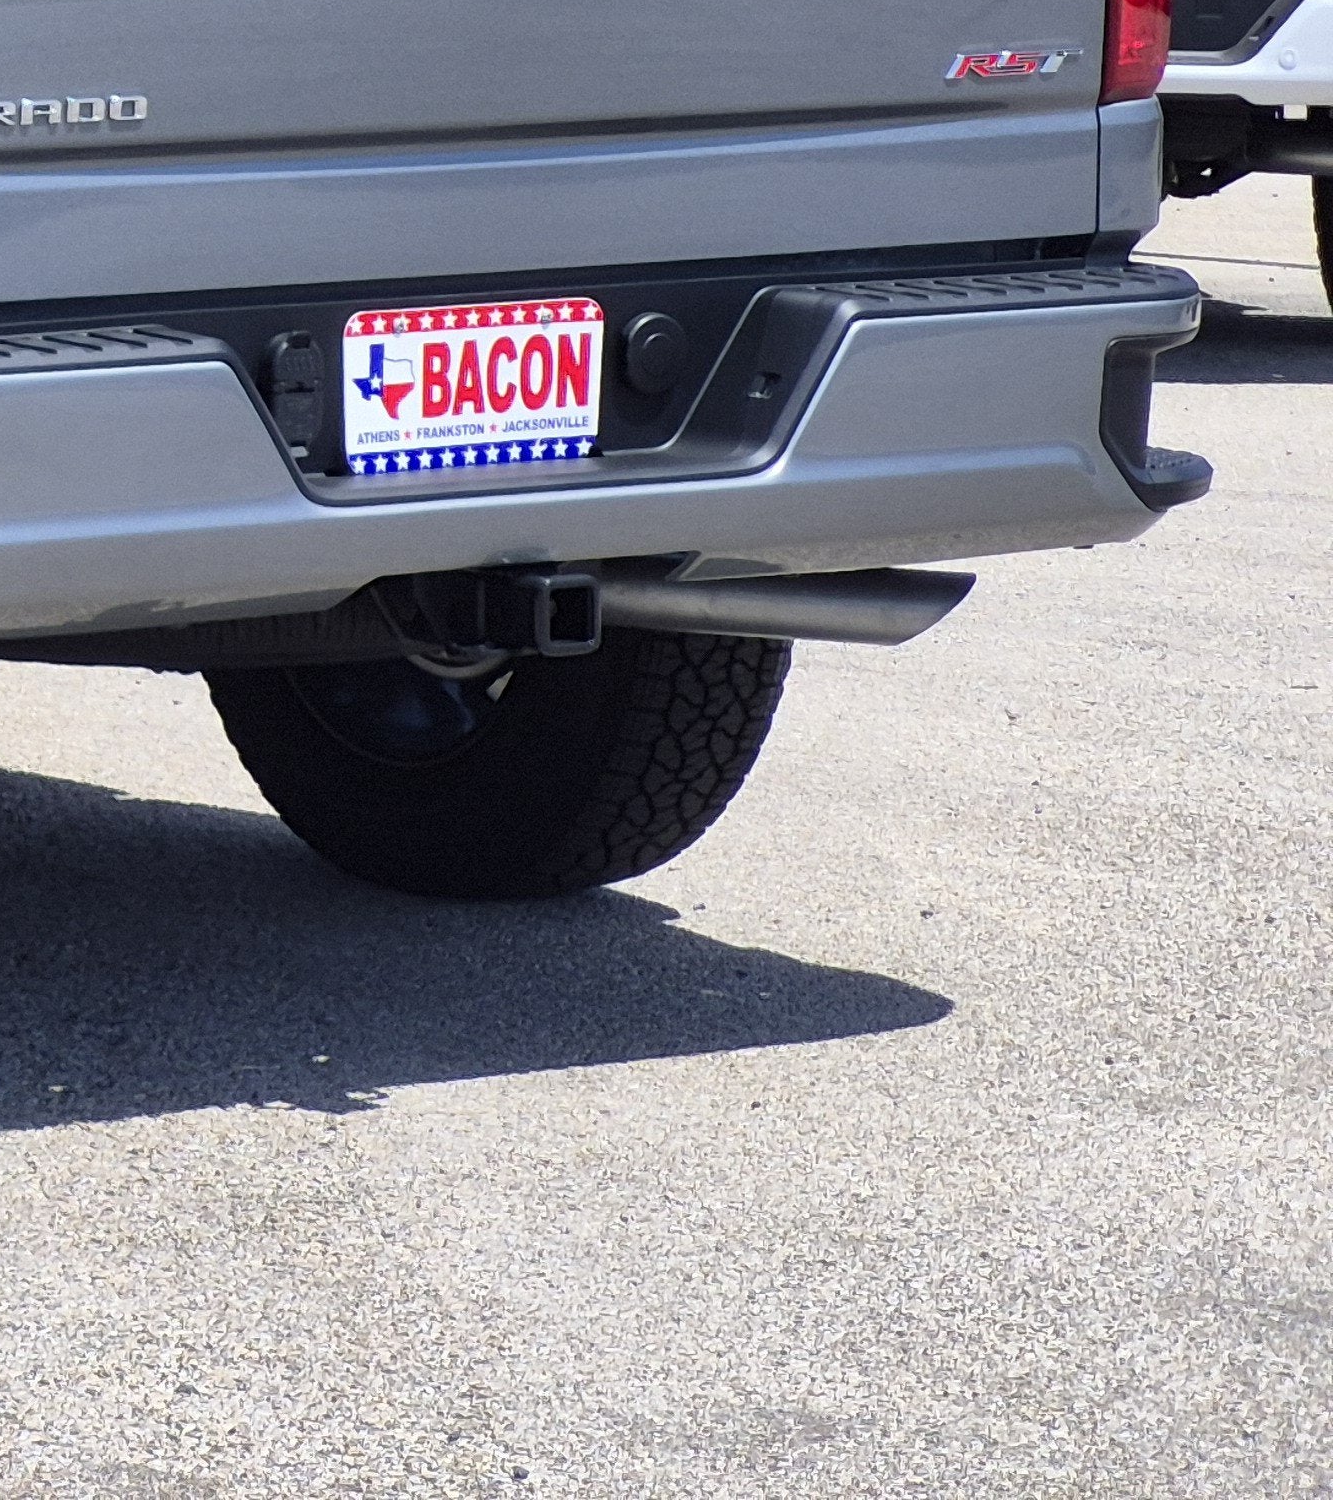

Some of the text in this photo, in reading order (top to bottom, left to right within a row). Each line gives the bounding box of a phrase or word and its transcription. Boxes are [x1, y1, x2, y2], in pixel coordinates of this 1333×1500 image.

[945, 49, 1084, 79] RST
[421, 332, 592, 418] BACON
[356, 415, 589, 445] ATHENS FRANKSTON JACKSONVILLE
